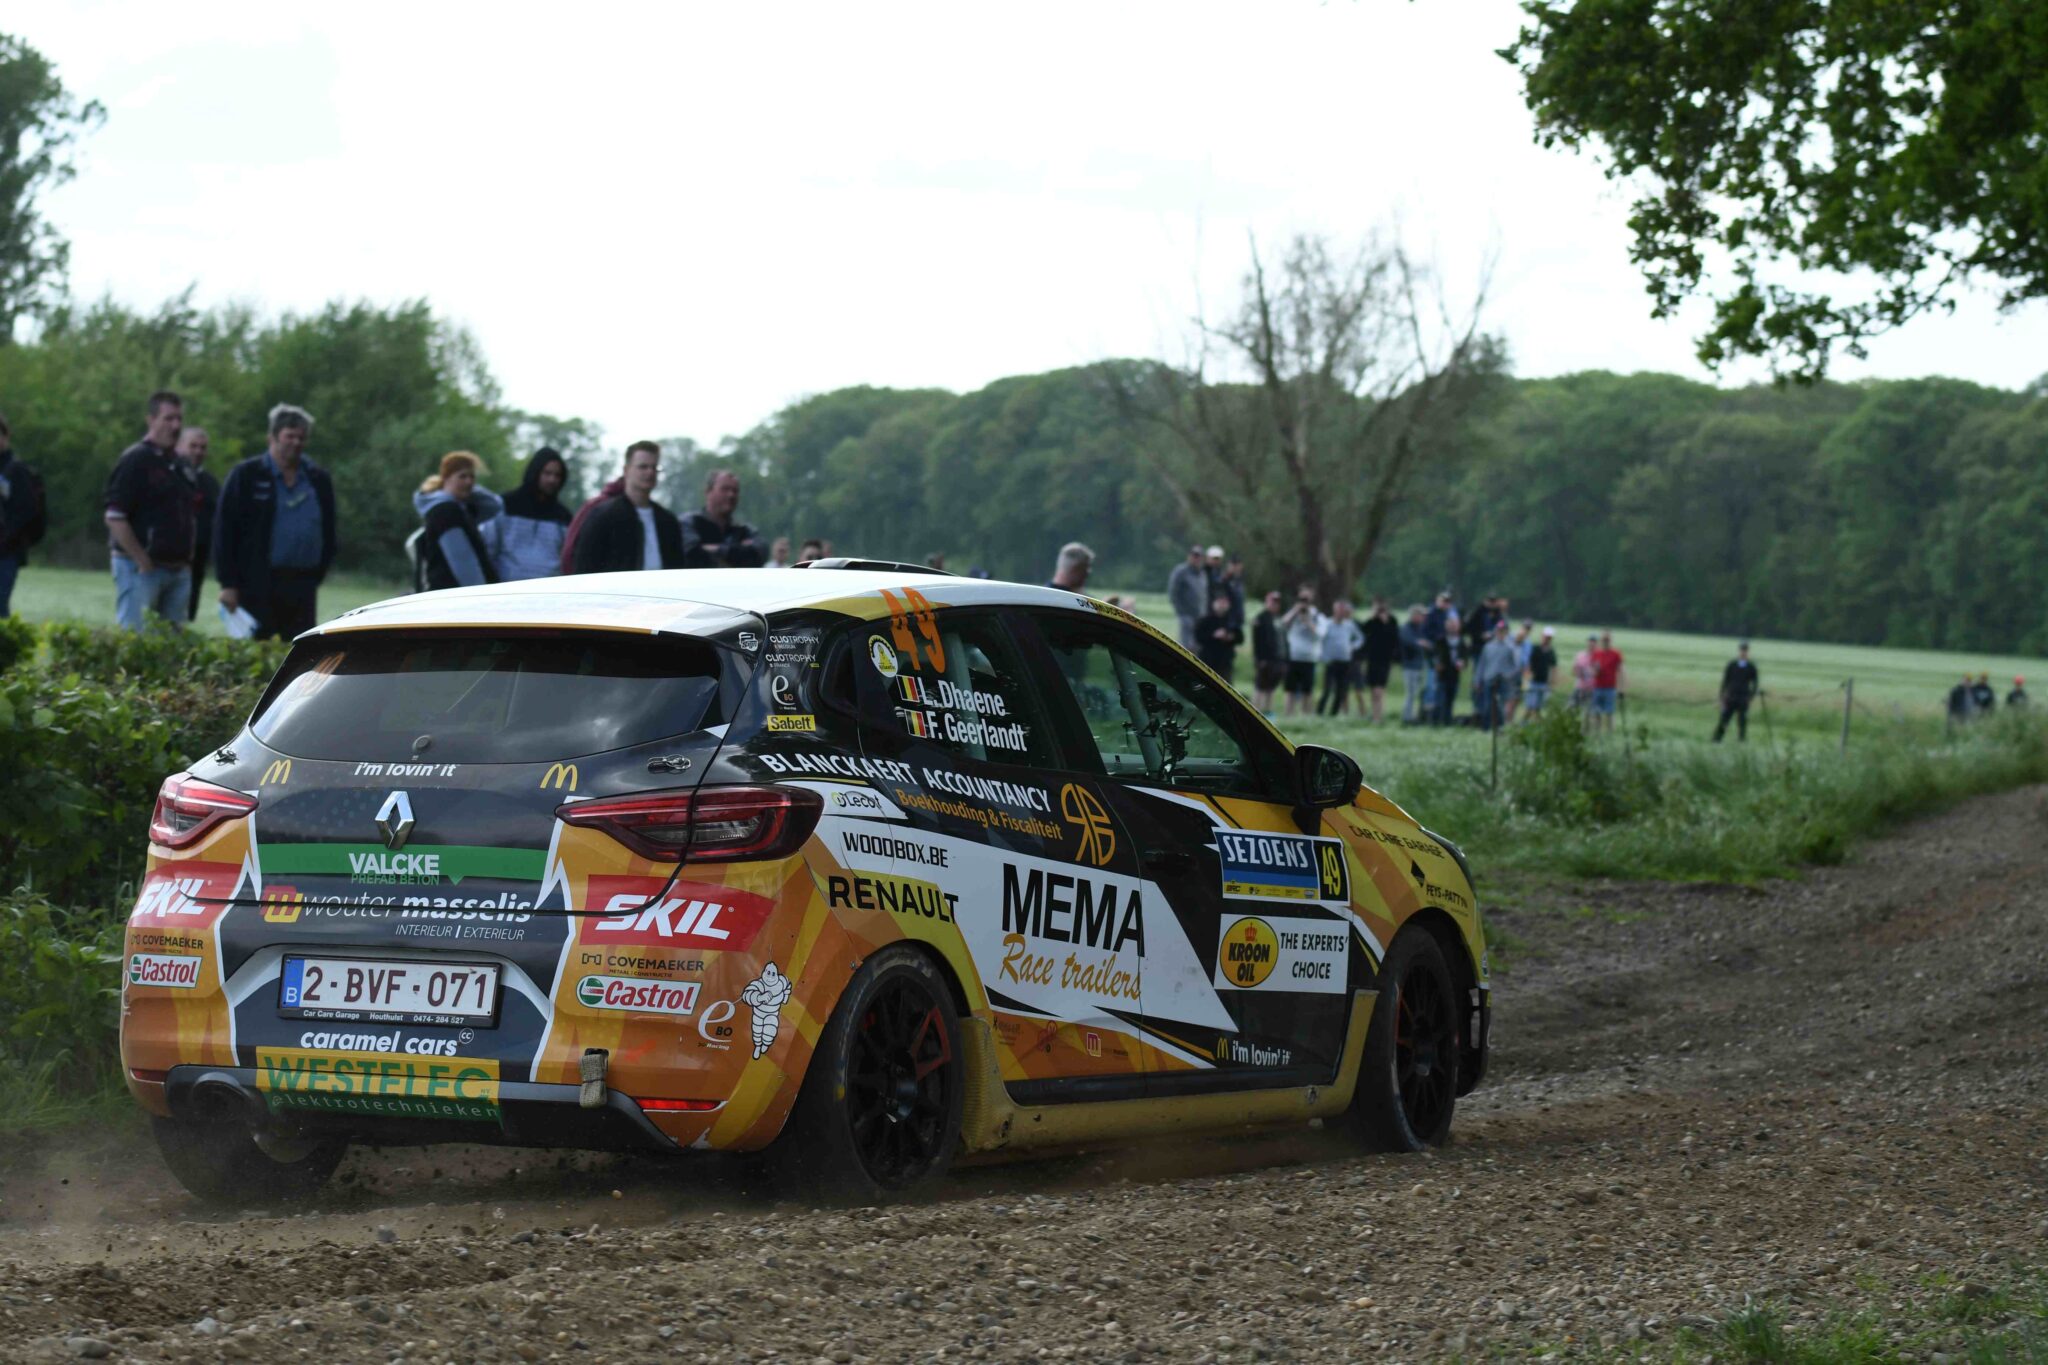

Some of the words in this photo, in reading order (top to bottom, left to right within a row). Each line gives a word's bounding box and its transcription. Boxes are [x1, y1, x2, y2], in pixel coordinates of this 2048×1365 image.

[769, 635, 819, 645] CLIOTROPHY
[879, 586, 946, 674] 49
[765, 653, 816, 663] CLIOTROPHY
[937, 679, 1006, 717] Dhaene
[770, 716, 812, 730] Sabelt
[925, 710, 943, 740] F.
[944, 712, 1028, 752] Geerlandt
[354, 762, 383, 776] i'm
[439, 764, 457, 777] it
[758, 753, 918, 785] BLANCKAERT
[922, 767, 1052, 813] ACCOUNTANCY
[895, 788, 989, 829] Boekhouding
[988, 808, 1000, 827] &
[998, 811, 1064, 841] Fiscaliteit
[842, 831, 949, 868] WOODBOX.BE
[1222, 835, 1309, 868] SEZOENS
[348, 852, 440, 876] VALCKE
[1322, 846, 1341, 896] 49
[351, 874, 397, 885] PREFAB
[400, 874, 440, 886] BETON
[131, 878, 206, 918] SKIL
[303, 891, 396, 918] wouter
[401, 893, 535, 923] masselis
[595, 880, 731, 941] SKIL
[829, 875, 959, 924] RENAULT
[1002, 862, 1145, 958] MEMA
[142, 934, 204, 950] COVEMAEKER
[395, 924, 453, 937] INTERIEUR
[463, 927, 525, 941] EXTERIEUR
[1280, 932, 1299, 950] THE
[1301, 933, 1348, 953] EXPERTS'
[607, 955, 705, 971] COVEMAEKER
[1228, 942, 1270, 962] KROON
[141, 957, 197, 984] Castrol
[999, 933, 1054, 985] Race
[1060, 951, 1142, 1000] trailers
[1237, 963, 1255, 982] OIL
[1292, 961, 1331, 980] CHOICE
[285, 987, 298, 1003] B
[605, 980, 695, 1011] Castrol
[317, 1010, 334, 1018] Care
[335, 1011, 360, 1020] Garage
[369, 1012, 404, 1021] Houthulst
[435, 1015, 450, 1023] 284
[300, 1030, 401, 1053] caramel
[404, 1036, 457, 1056] cars
[1282, 1049, 1291, 1065] it
[264, 1055, 492, 1102] WESTELEC
